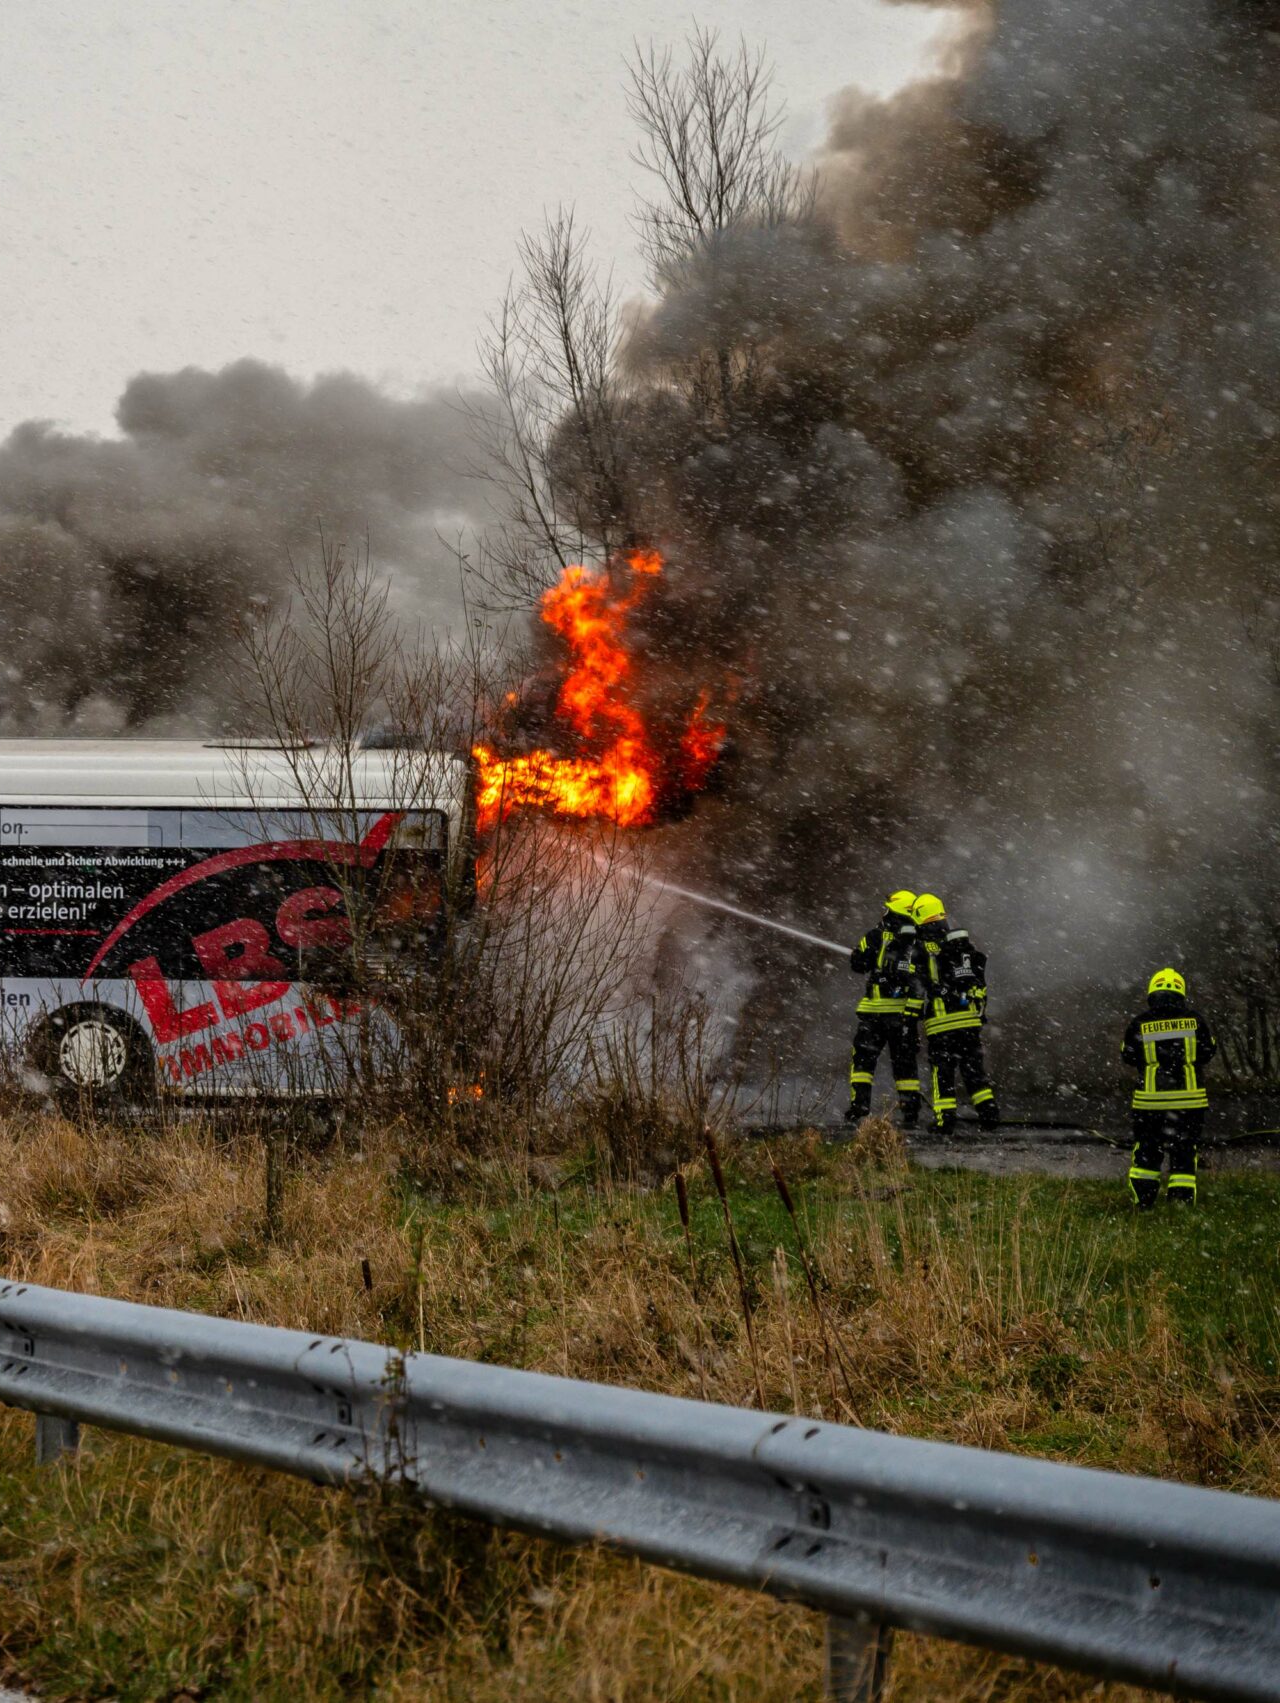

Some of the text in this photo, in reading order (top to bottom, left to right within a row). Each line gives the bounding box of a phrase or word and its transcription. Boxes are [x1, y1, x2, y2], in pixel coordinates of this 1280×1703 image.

[2, 855, 44, 867] schnelle
[45, 856, 66, 867] und
[67, 856, 102, 867] sichere
[104, 856, 164, 868] Abwicklung
[28, 880, 124, 902] optimalen
[8, 901, 97, 920] erzielen!“
[1142, 1019, 1197, 1034] FEUERWEHR
